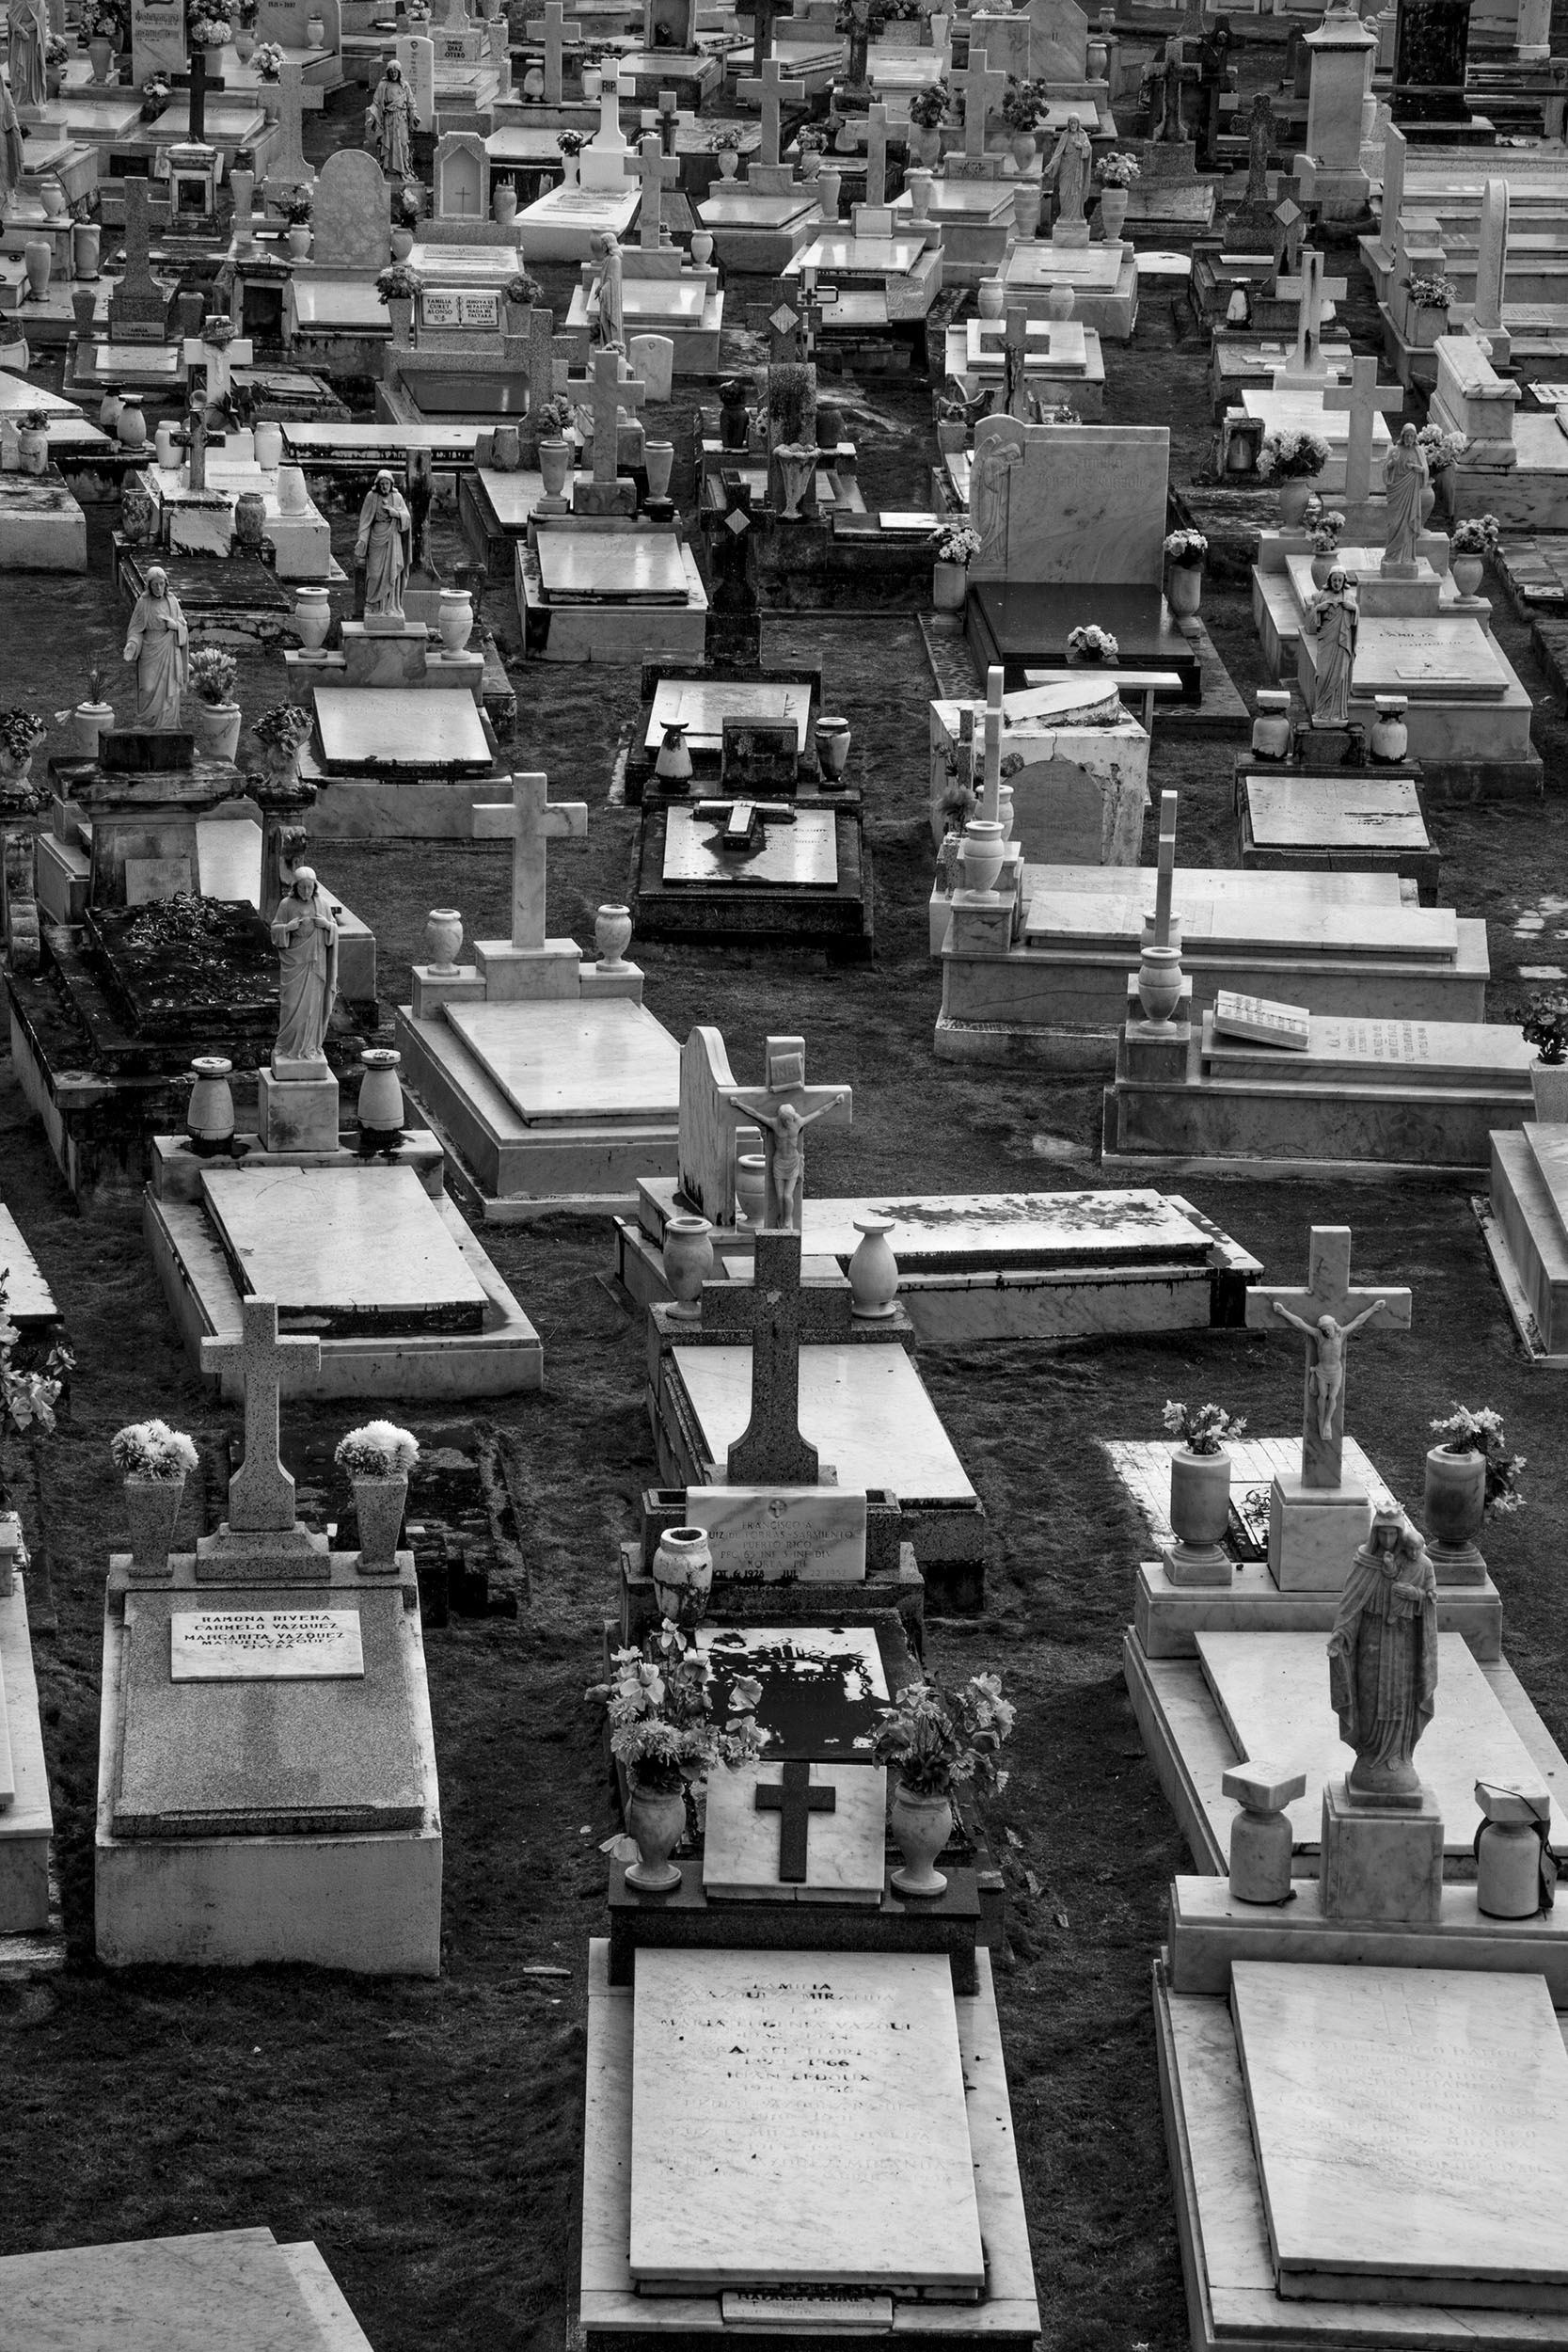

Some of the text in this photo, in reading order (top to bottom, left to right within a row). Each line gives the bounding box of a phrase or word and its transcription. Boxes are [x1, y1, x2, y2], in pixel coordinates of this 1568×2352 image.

[601, 80, 616, 93] RIP
[741, 1520, 814, 1530] FRANCISCO A
[708, 1531, 724, 1540] UIZ
[743, 1540, 812, 1549] PUERTO RICO
[721, 1550, 738, 1559] PFC
[747, 1560, 783, 1569] KOREA
[802, 1992, 895, 2001] MIRANDA
[660, 2018, 726, 2027] MARIA
